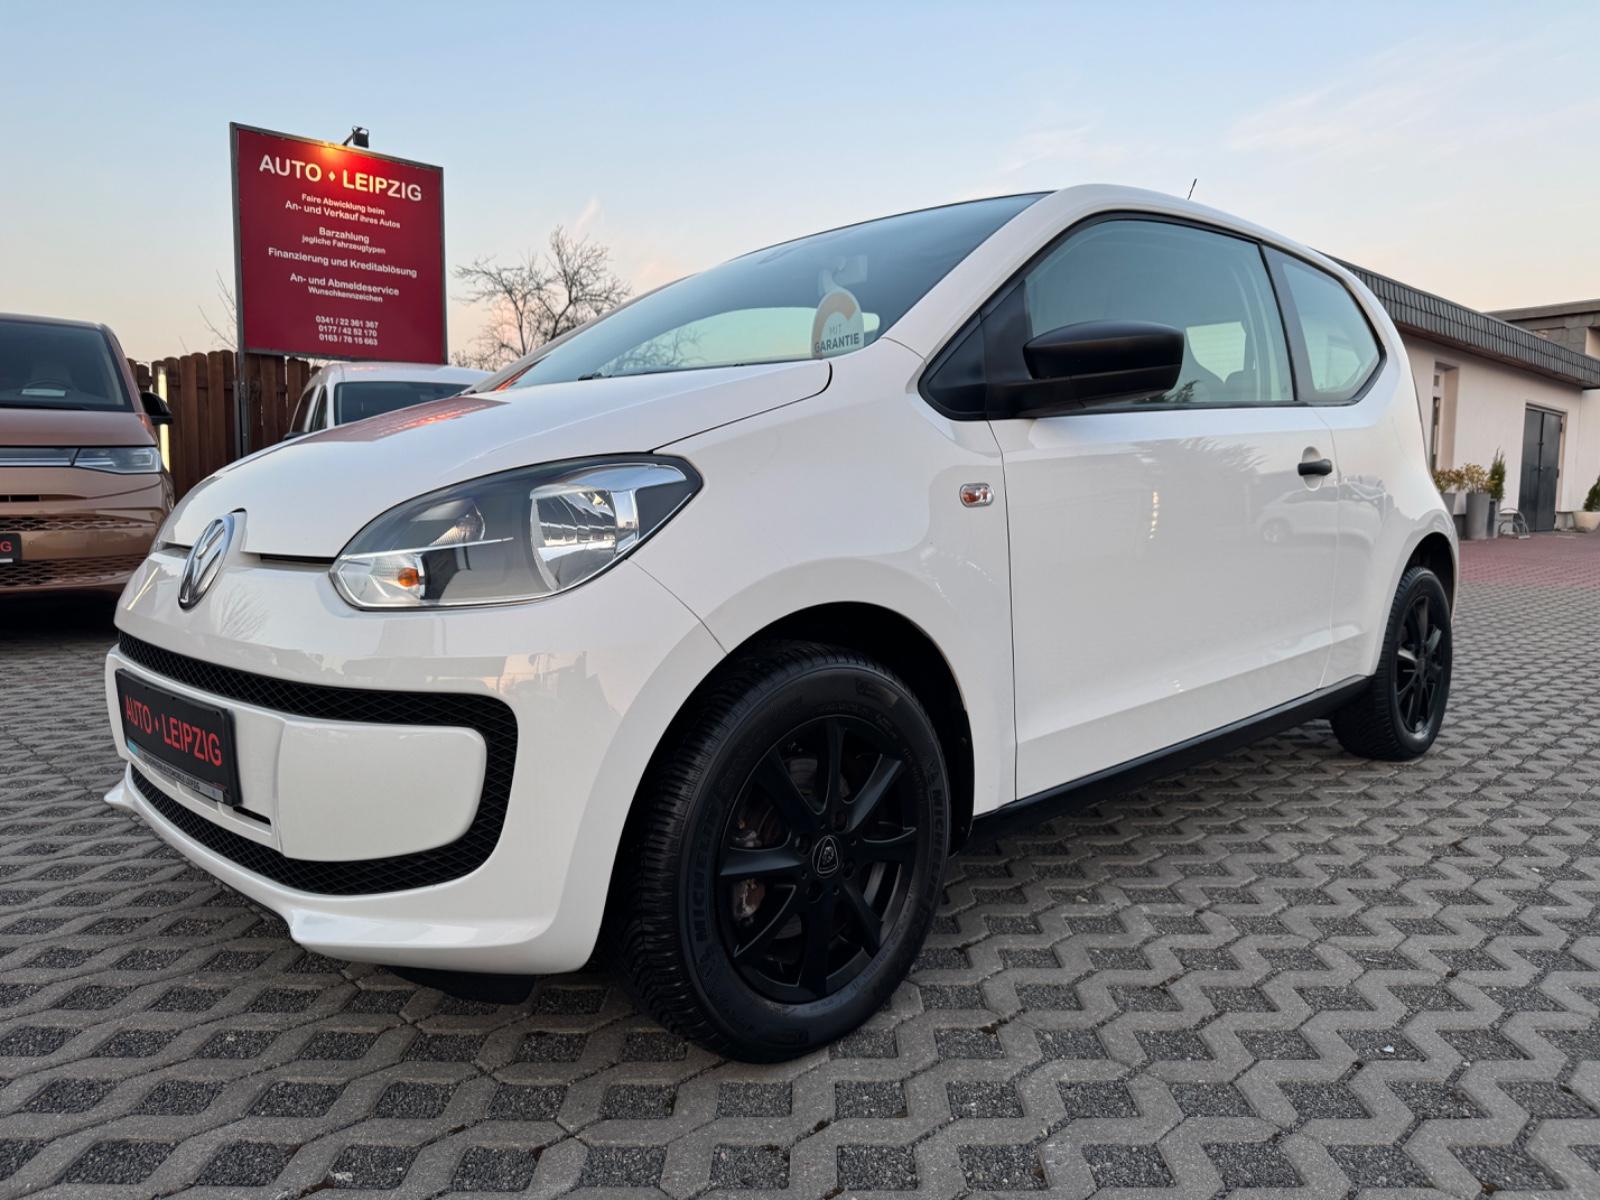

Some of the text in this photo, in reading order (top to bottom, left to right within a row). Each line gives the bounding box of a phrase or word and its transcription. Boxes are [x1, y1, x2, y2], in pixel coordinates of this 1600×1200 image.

[259, 154, 422, 202] AUTO LEIPZIG
[285, 200, 302, 210] An-
[304, 205, 322, 215] und
[323, 206, 359, 221] Verkauf
[379, 218, 400, 229] Autos
[301, 193, 385, 215] Faire Abwicklung beim
[301, 234, 386, 255] jegliche Fahrzeugtypen
[319, 226, 369, 244] Barzahlung
[268, 246, 417, 278] Finanzierung und Kreditablösung
[290, 272, 400, 296] An- und Abmeldeservice
[308, 286, 383, 303] Wunschkennzeichen
[315, 315, 334, 324] 0341
[318, 324, 337, 333] 0177
[814, 333, 860, 353] GARANTIE
[124, 694, 223, 767] AUTO LEIPZIG
